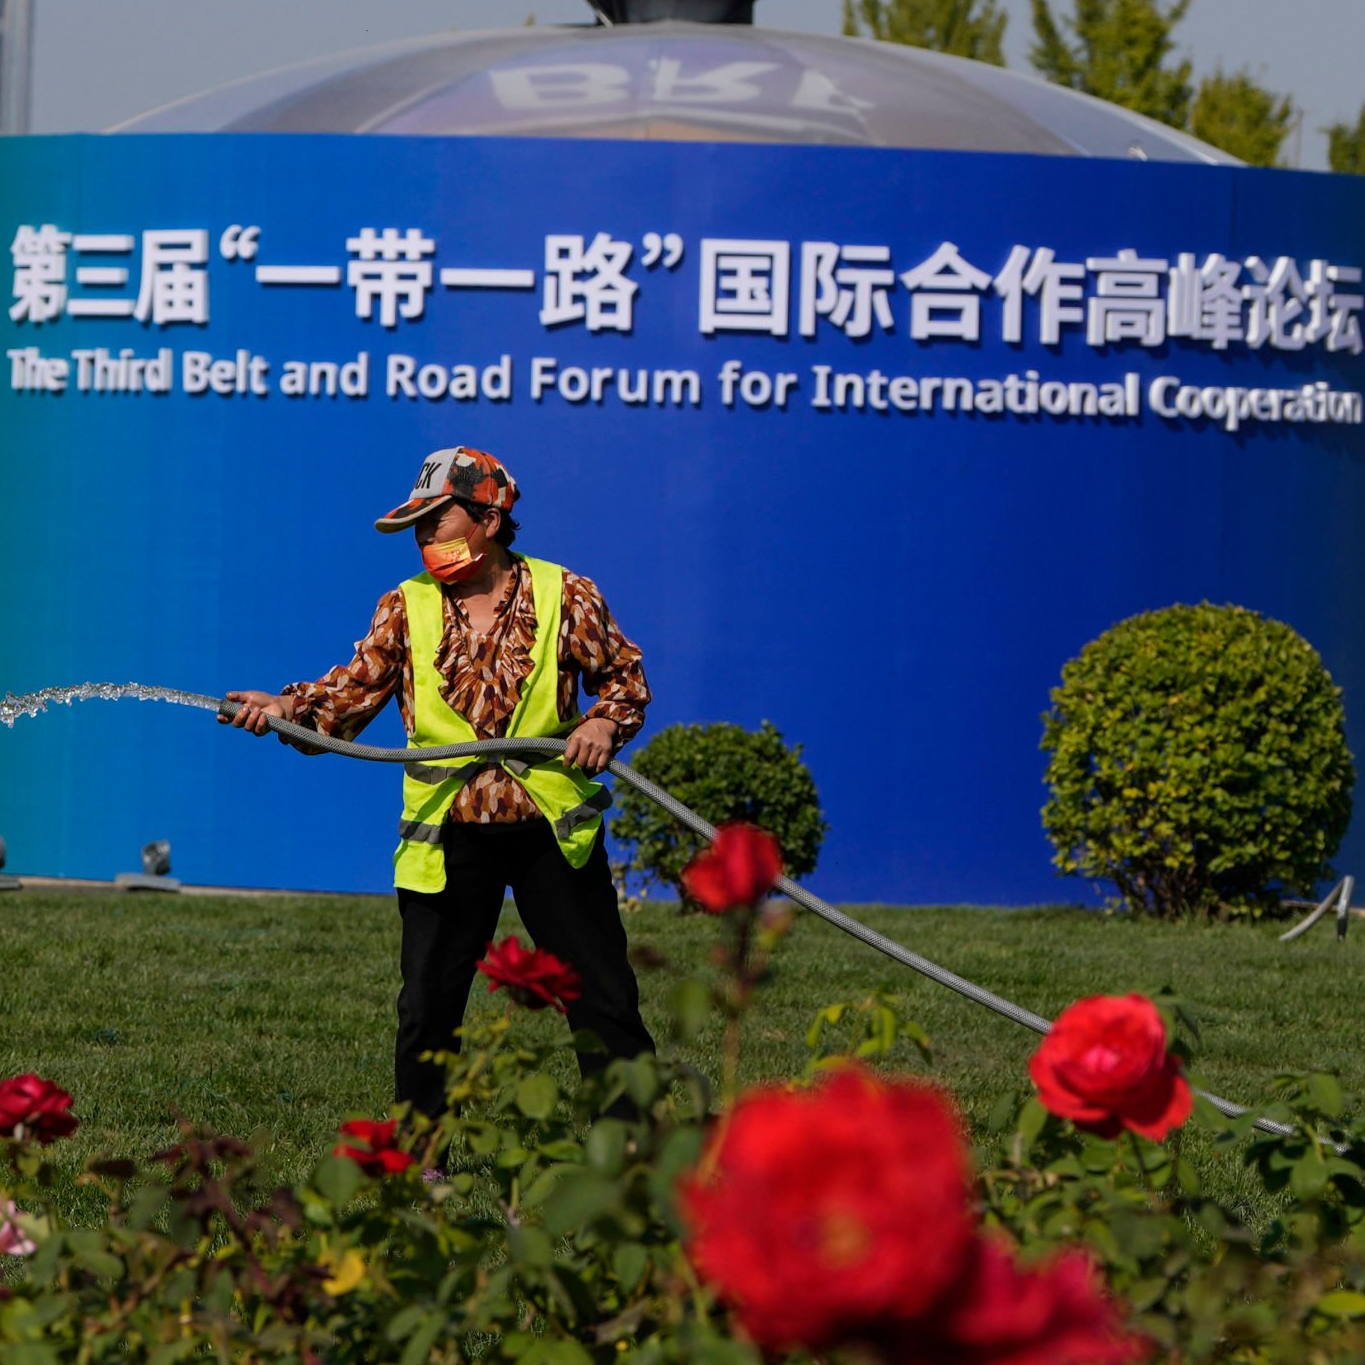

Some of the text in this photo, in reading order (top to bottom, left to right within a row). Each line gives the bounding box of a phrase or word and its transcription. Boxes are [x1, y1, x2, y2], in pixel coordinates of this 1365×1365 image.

[6, 346, 1363, 431] The Third Belt and Road Forum for International Cooperation
